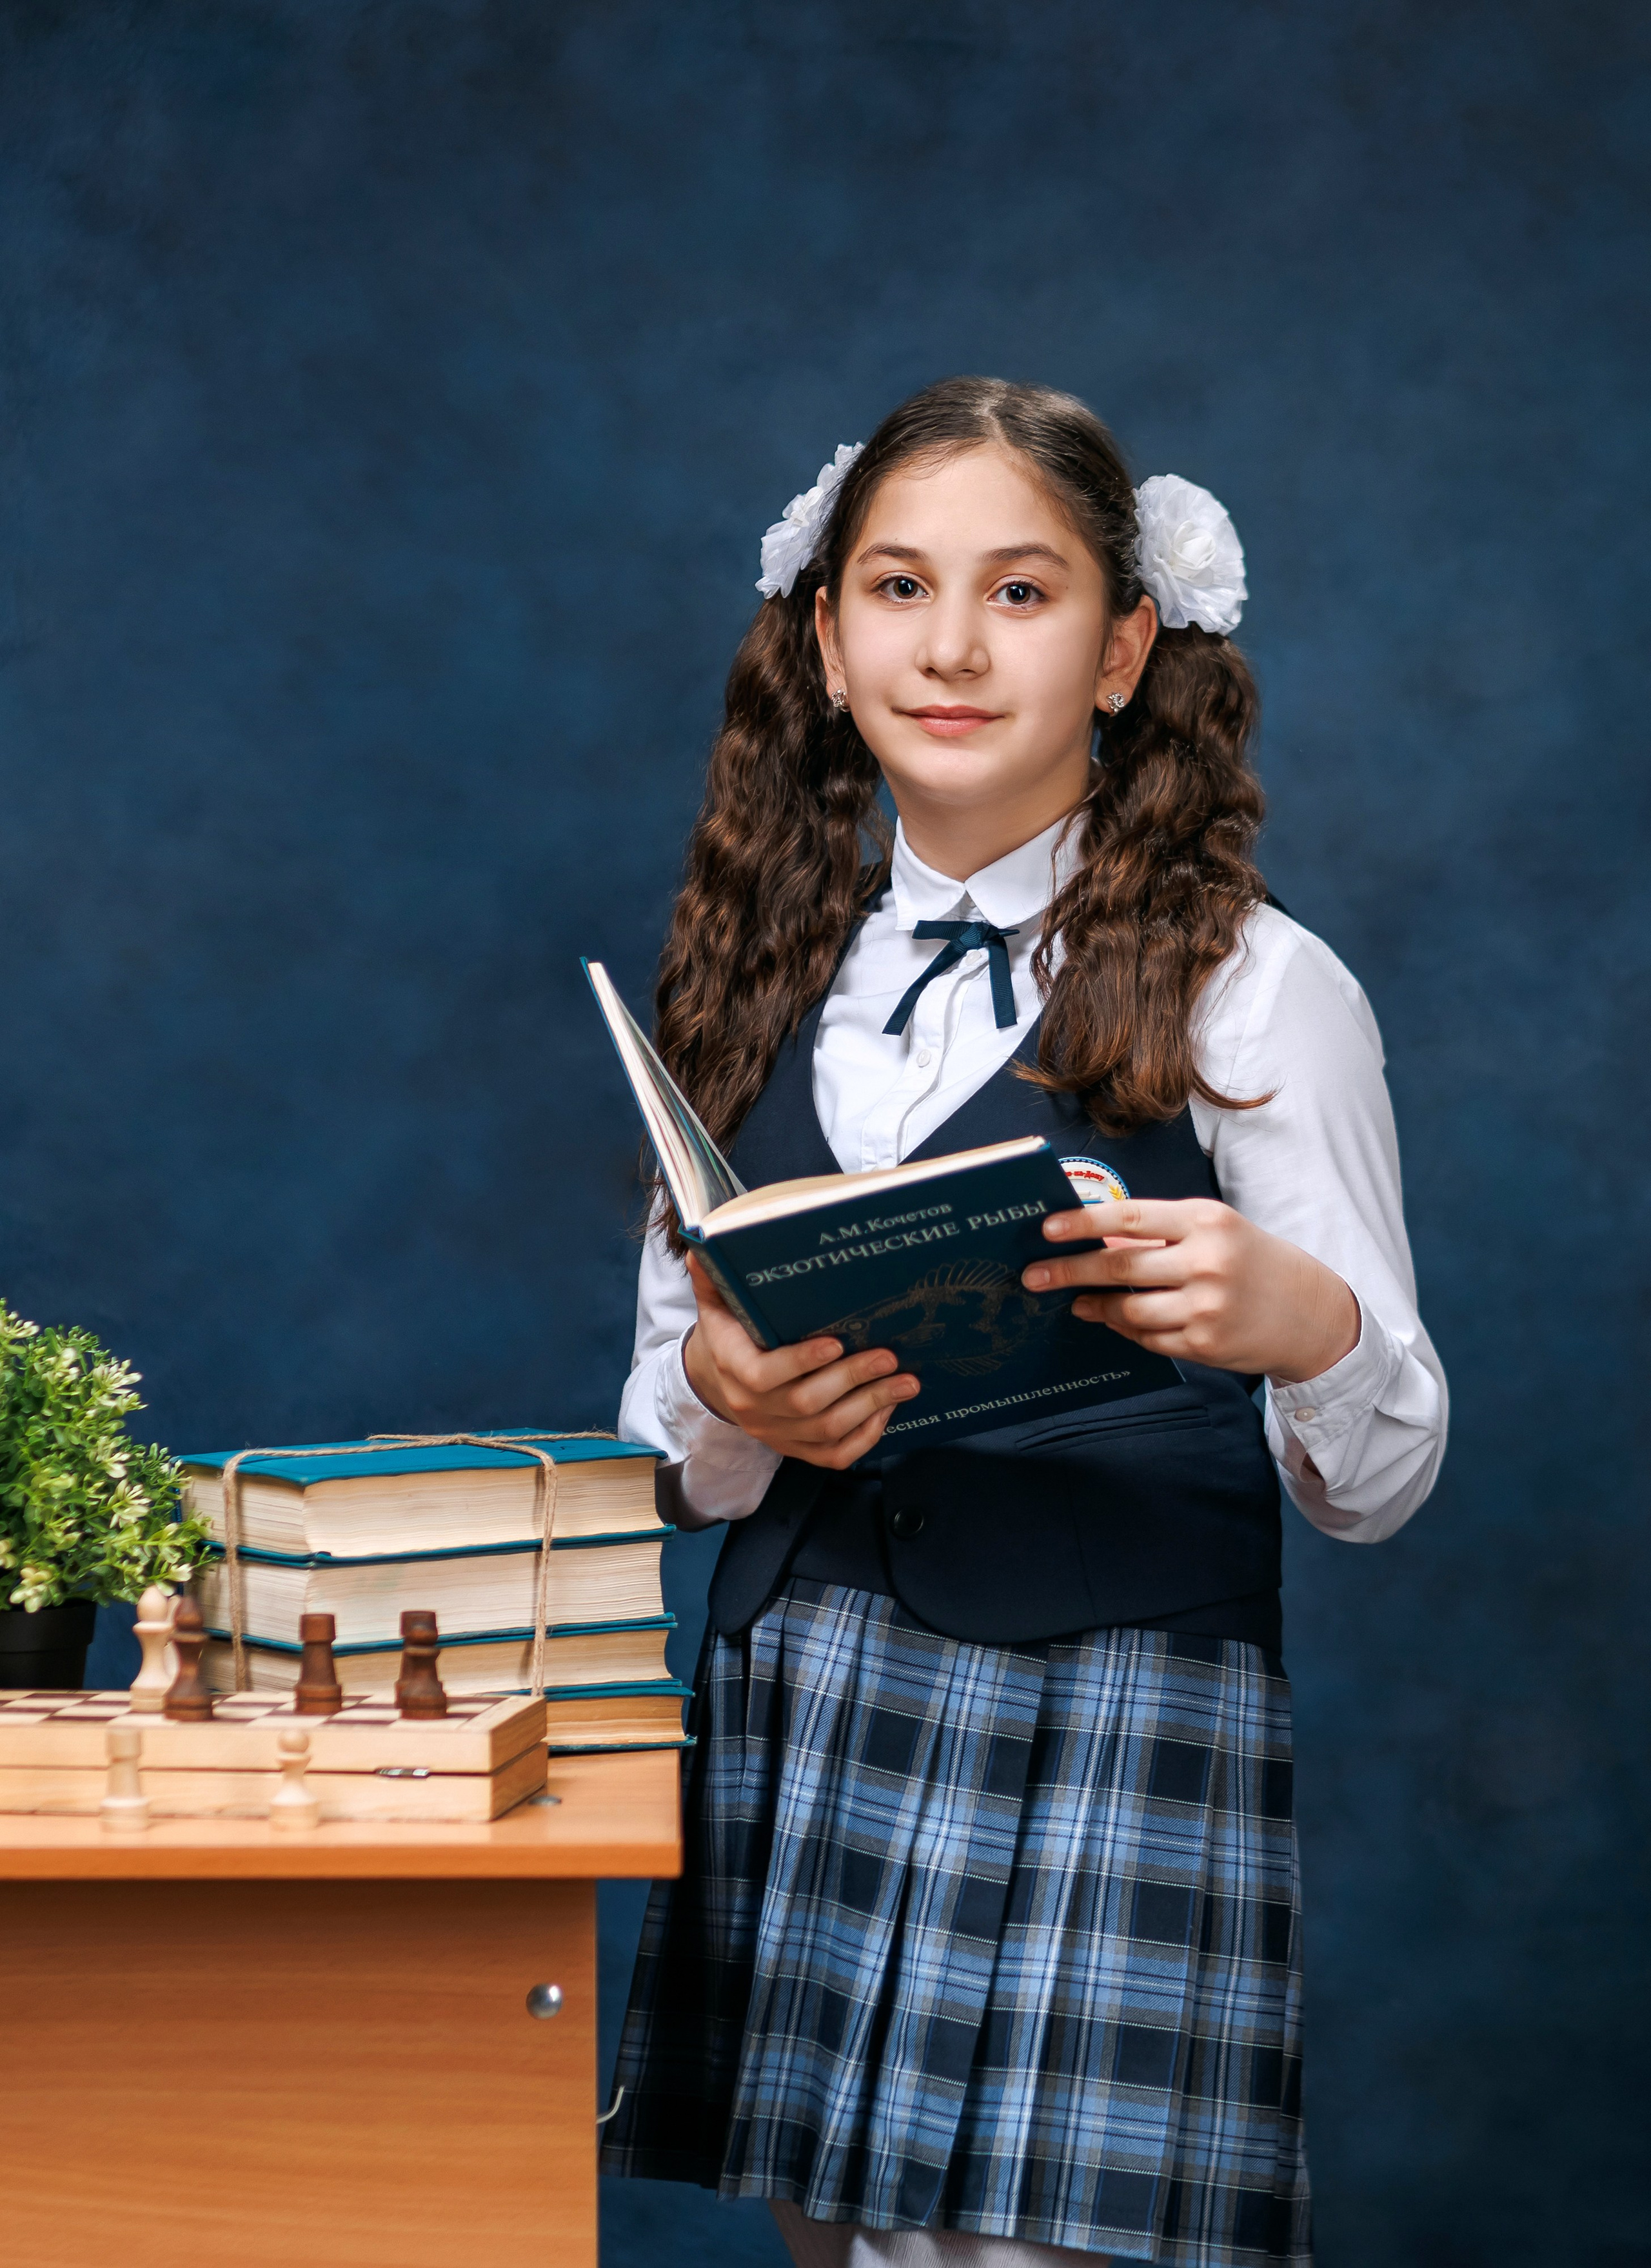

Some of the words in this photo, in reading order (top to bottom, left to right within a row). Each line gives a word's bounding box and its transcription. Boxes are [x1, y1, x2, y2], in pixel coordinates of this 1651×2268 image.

[746, 1222, 960, 1287] ЭКЗОТИЧЕСКИЕ
[967, 1200, 1048, 1231] РЫБЫ
[944, 1371, 1131, 1420] промышленность»
